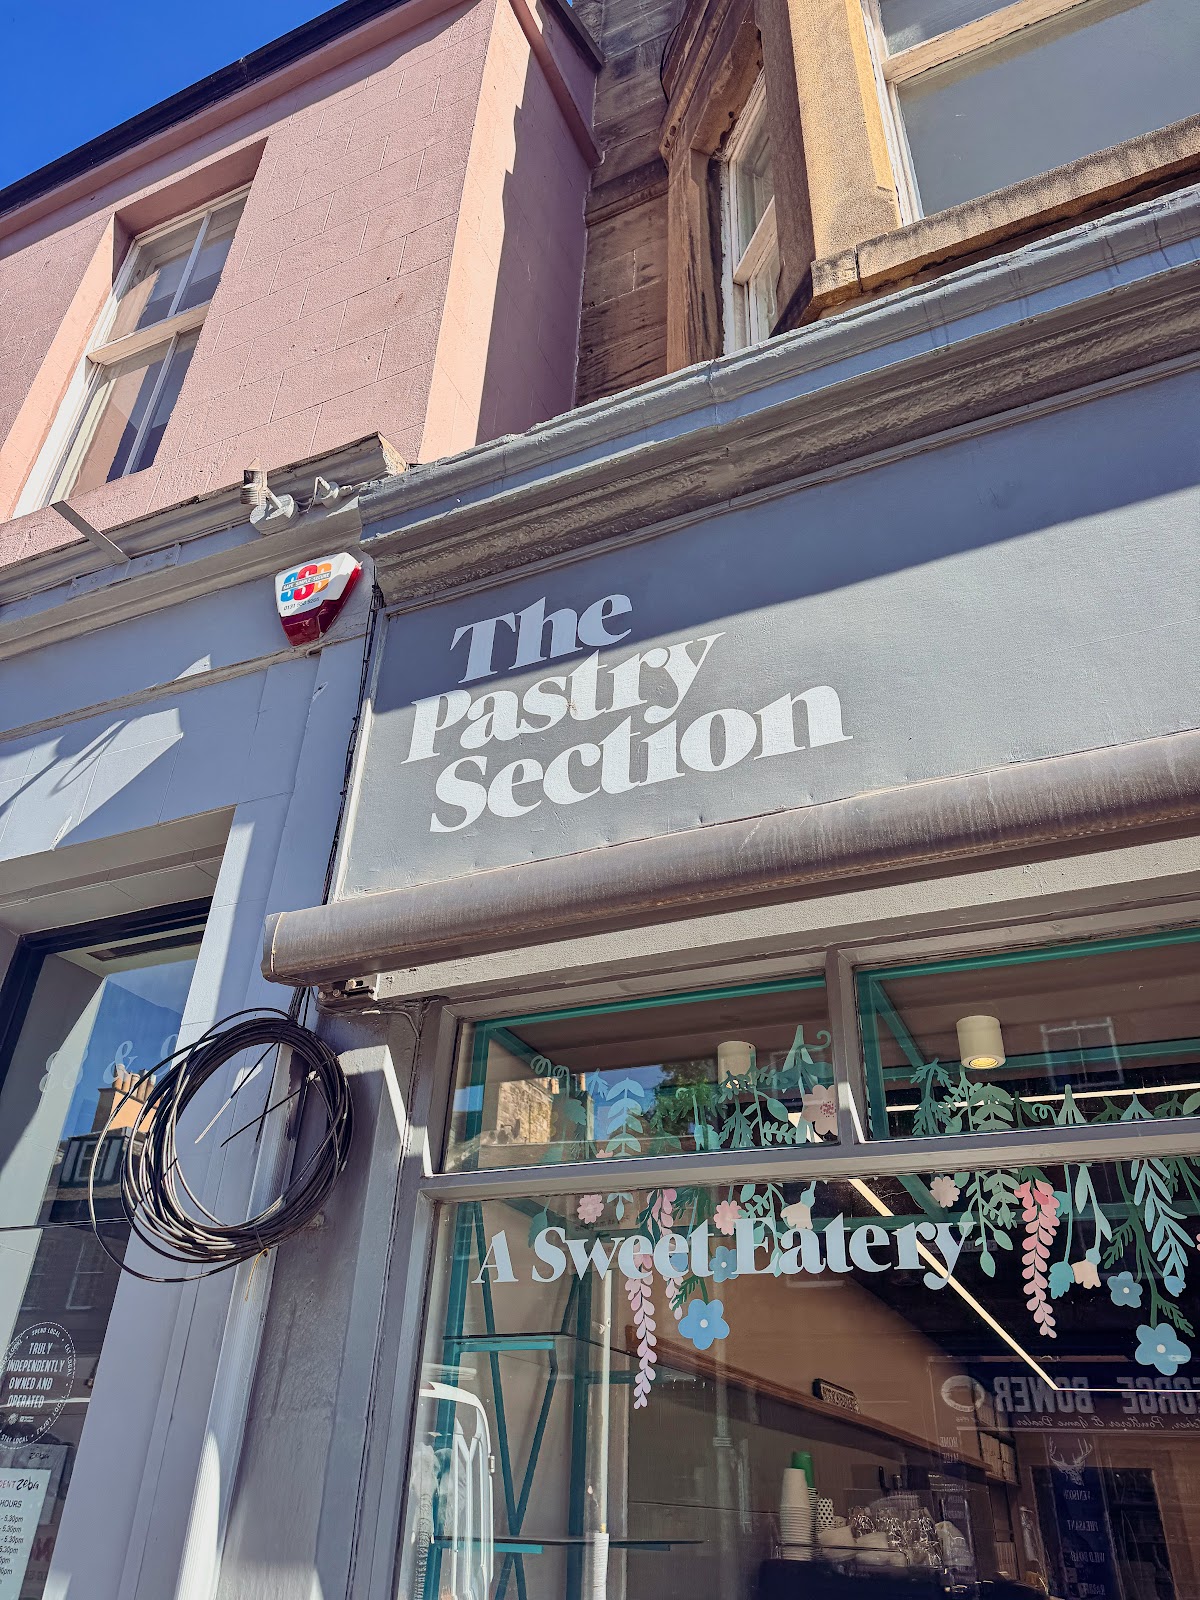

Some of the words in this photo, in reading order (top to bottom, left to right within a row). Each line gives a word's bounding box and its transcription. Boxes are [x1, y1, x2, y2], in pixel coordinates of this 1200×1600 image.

[449, 593, 633, 684] The
[400, 631, 726, 764] Pastry
[429, 685, 853, 833] Section
[470, 1229, 519, 1285] A
[531, 1218, 715, 1284] Sweet
[730, 1211, 978, 1291] Eatery
[47, 1327, 61, 1338] LOCAL
[29, 1342, 54, 1355] TRULY
[6, 1359, 66, 1372] INDEPENDENTLY
[9, 1377, 36, 1390] OWNED
[36, 1377, 53, 1390] AND
[7, 1395, 45, 1408] OPERATED
[13, 1435, 28, 1445] LOCAL
[0, 1499, 22, 1508] HOURS
